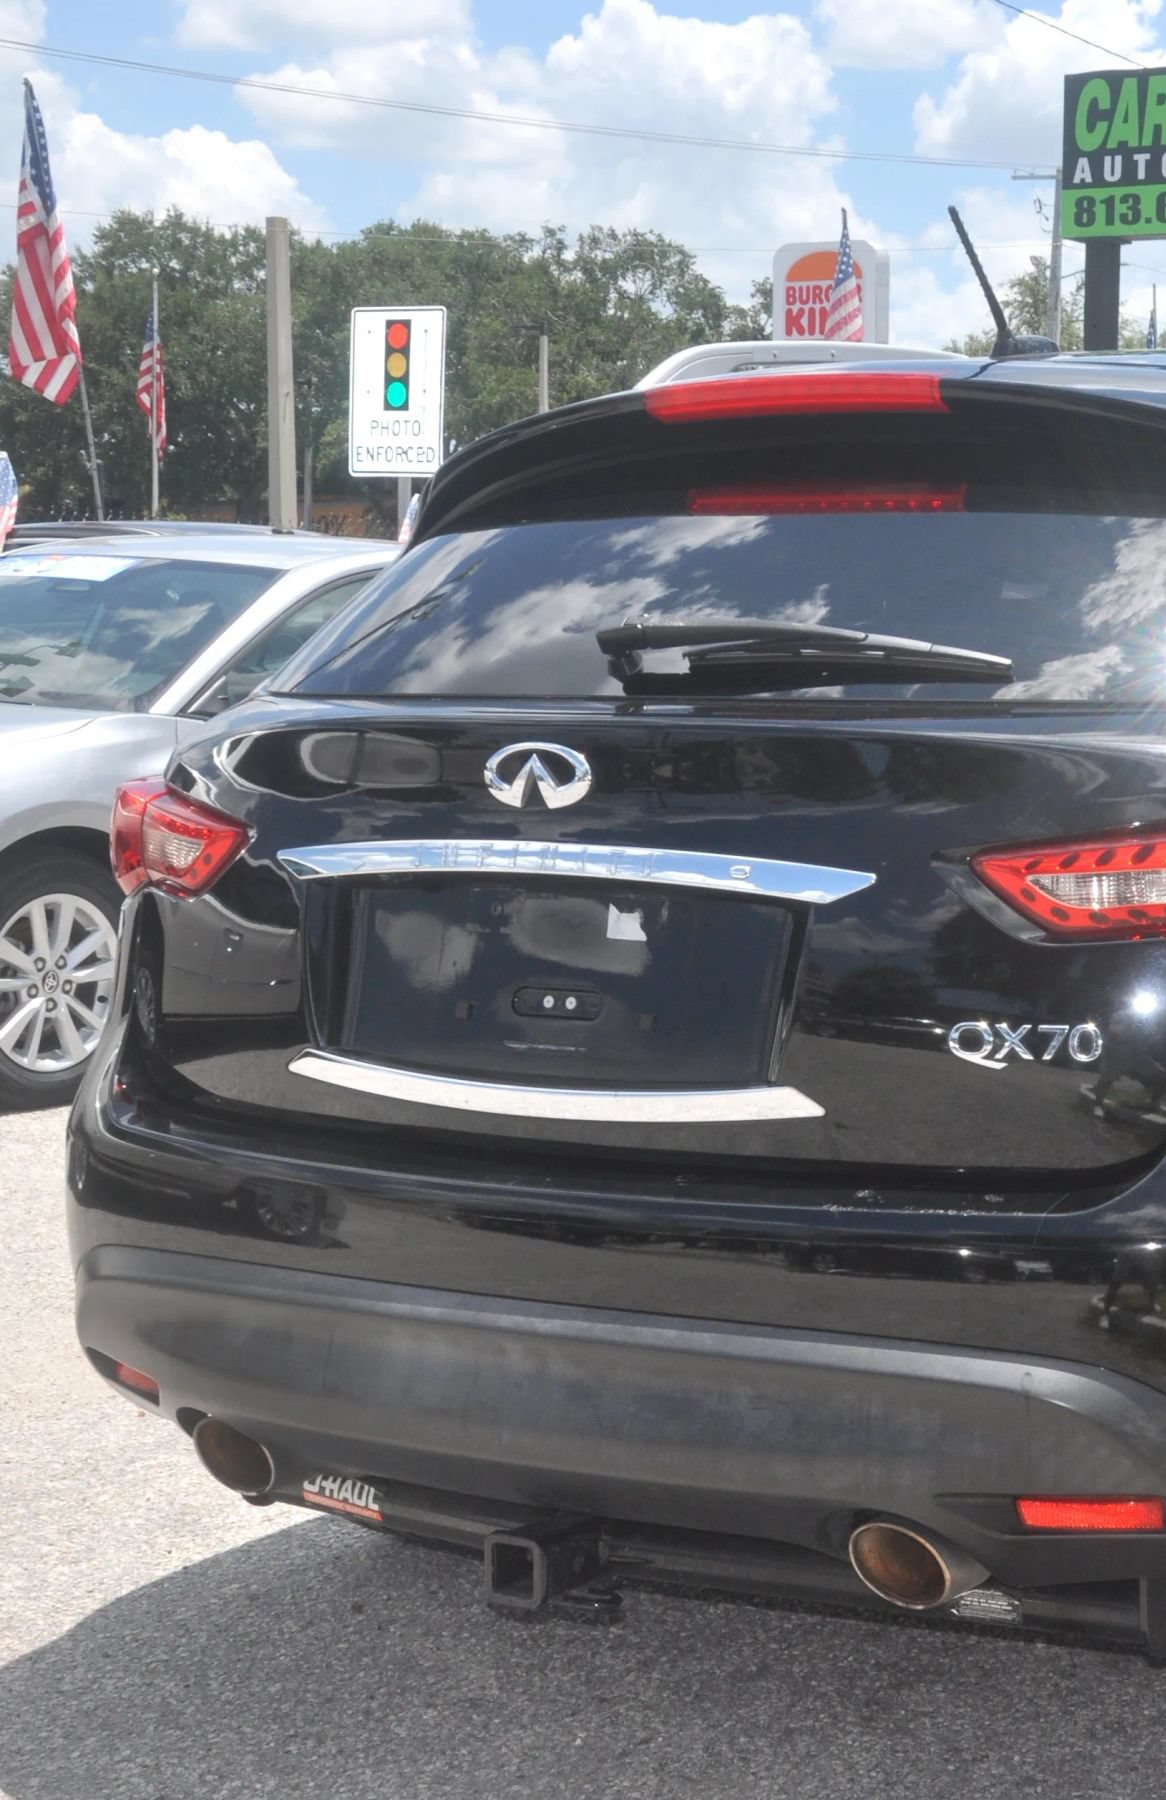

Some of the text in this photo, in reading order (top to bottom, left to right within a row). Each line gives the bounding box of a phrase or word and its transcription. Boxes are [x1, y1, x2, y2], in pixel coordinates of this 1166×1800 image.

[370, 419, 422, 437] PHOTO
[356, 446, 436, 463] ENFORCED
[949, 1021, 1103, 1070] QX70
